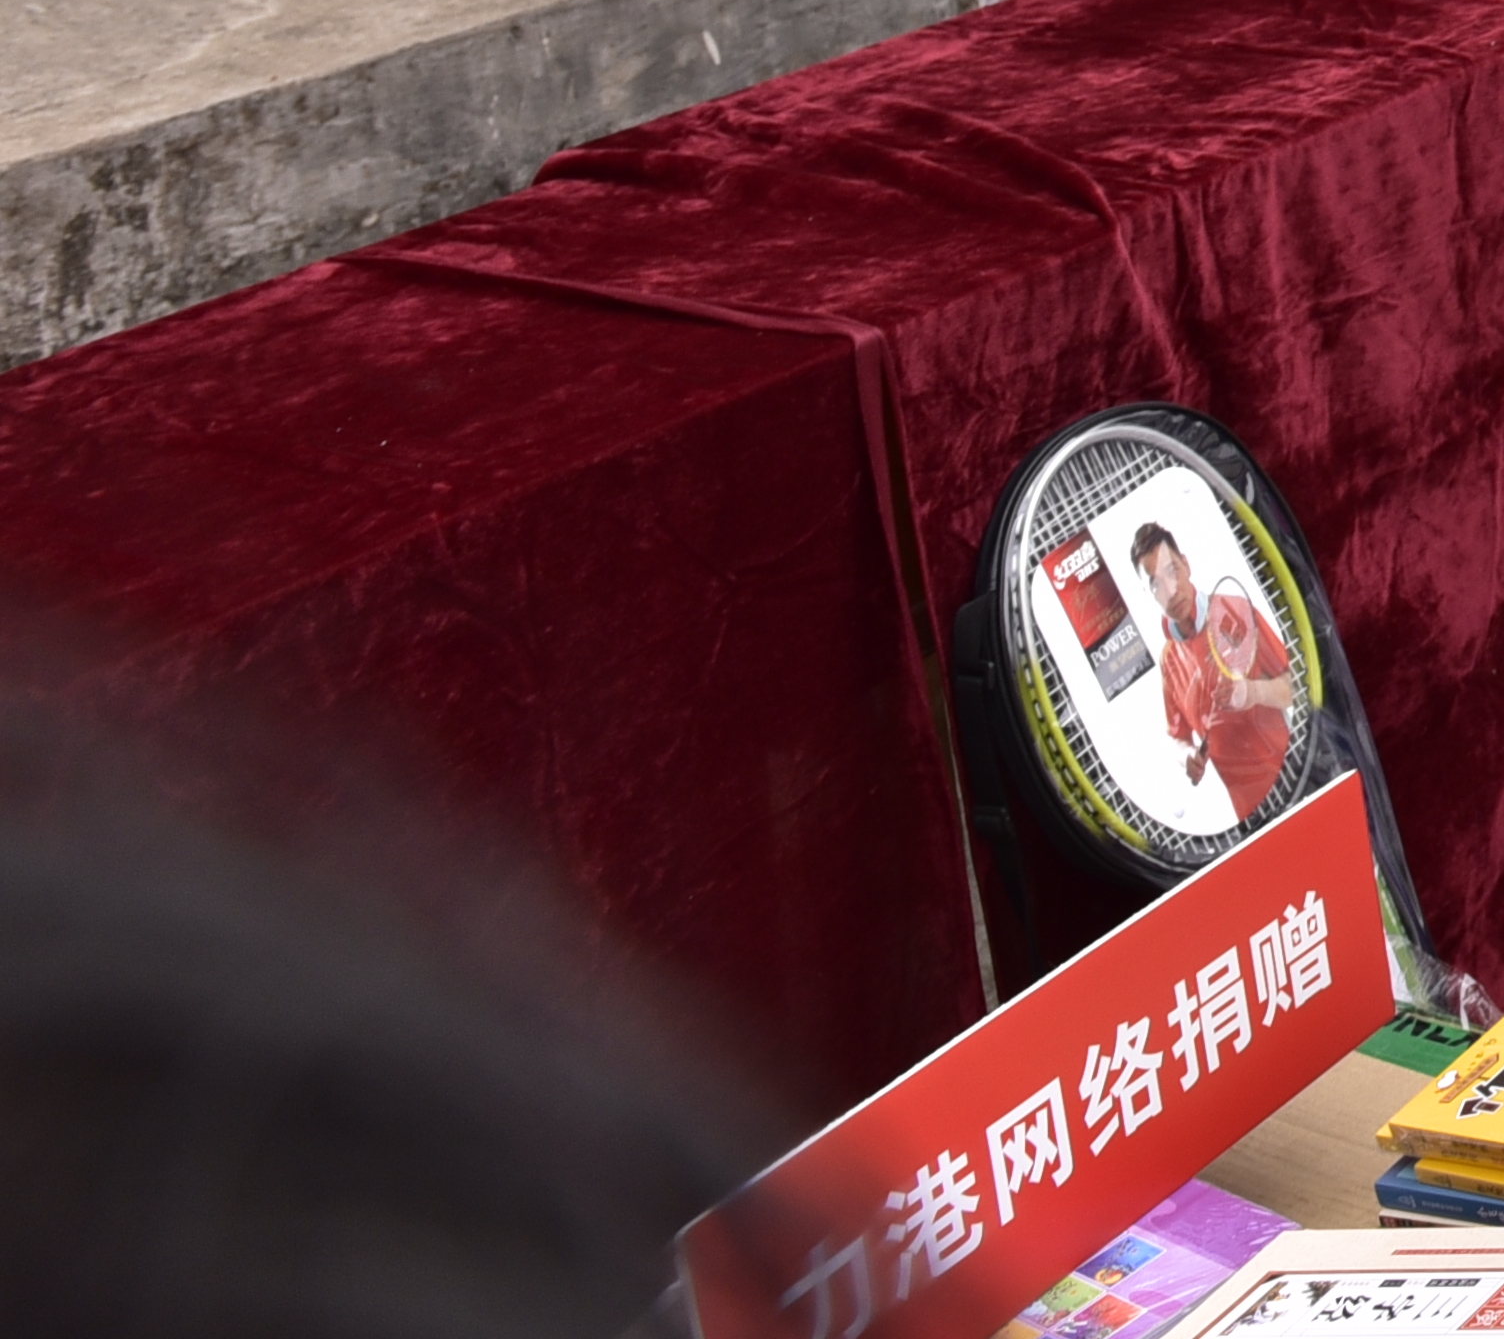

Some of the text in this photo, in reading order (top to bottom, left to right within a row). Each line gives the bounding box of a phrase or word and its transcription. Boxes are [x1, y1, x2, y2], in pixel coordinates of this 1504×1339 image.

[1090, 623, 1139, 668] POWER
[1313, 1291, 1471, 1322] 三字经
